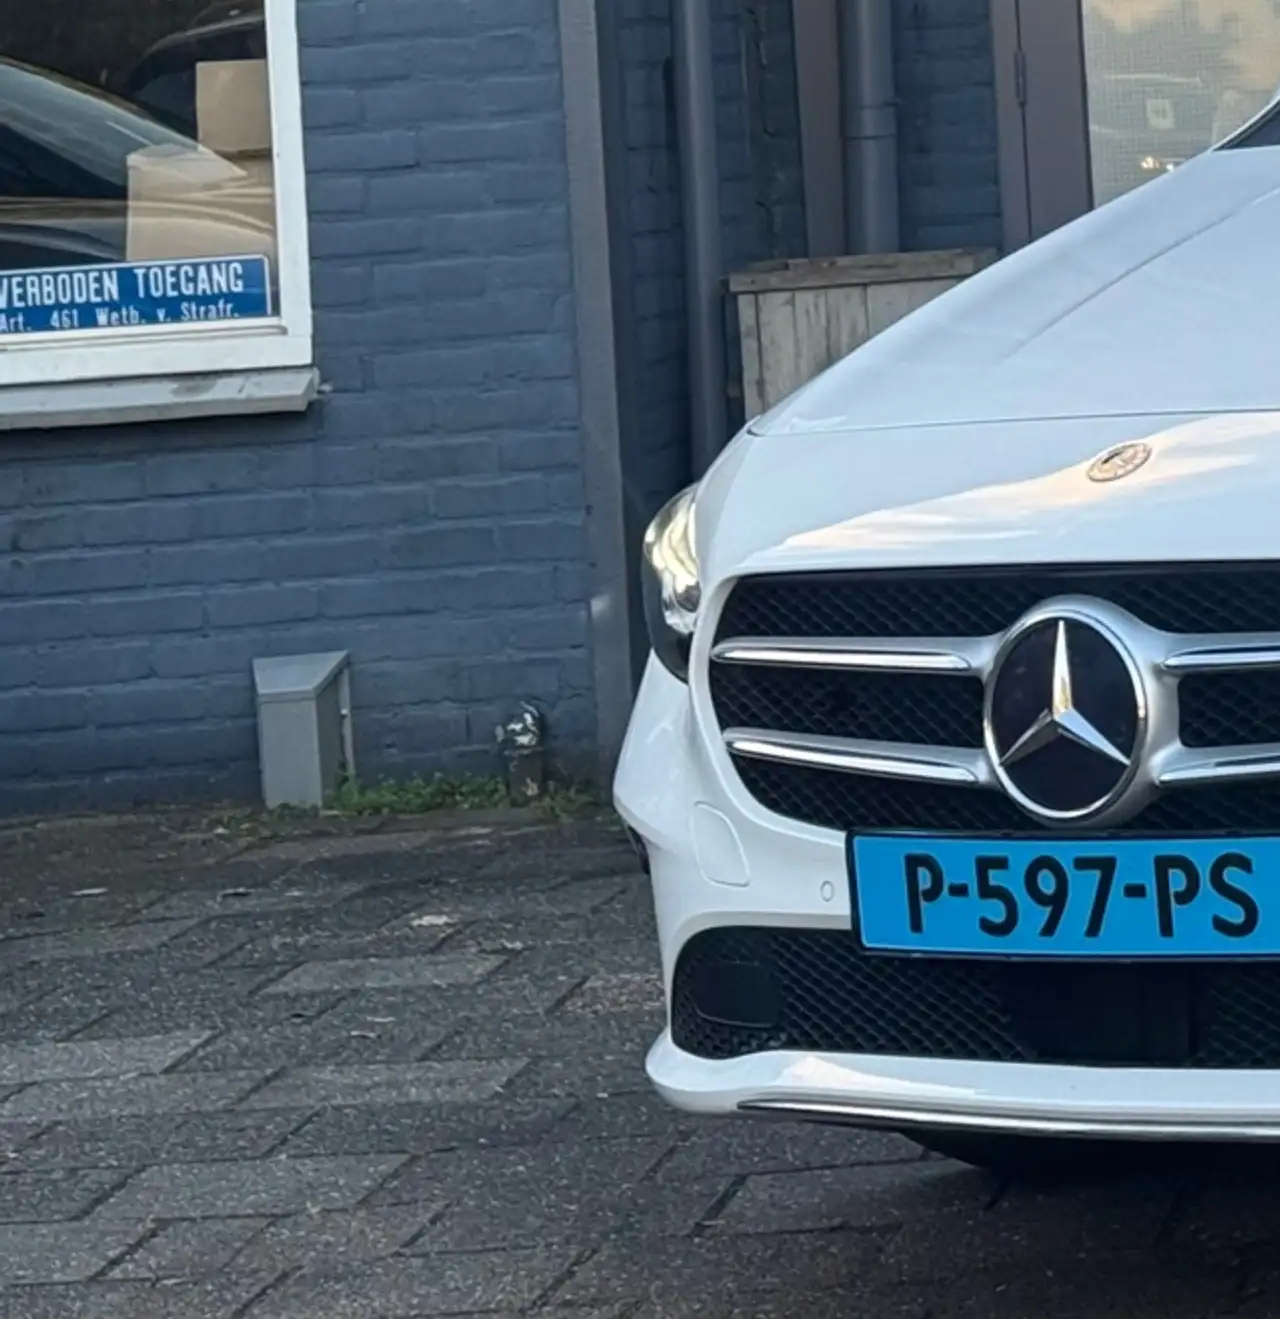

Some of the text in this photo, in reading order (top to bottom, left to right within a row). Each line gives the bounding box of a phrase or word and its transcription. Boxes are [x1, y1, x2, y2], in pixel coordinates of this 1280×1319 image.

[132, 262, 243, 298] TOEGANG
[50, 309, 79, 329] 461
[904, 851, 1260, 938] P-597-PS
